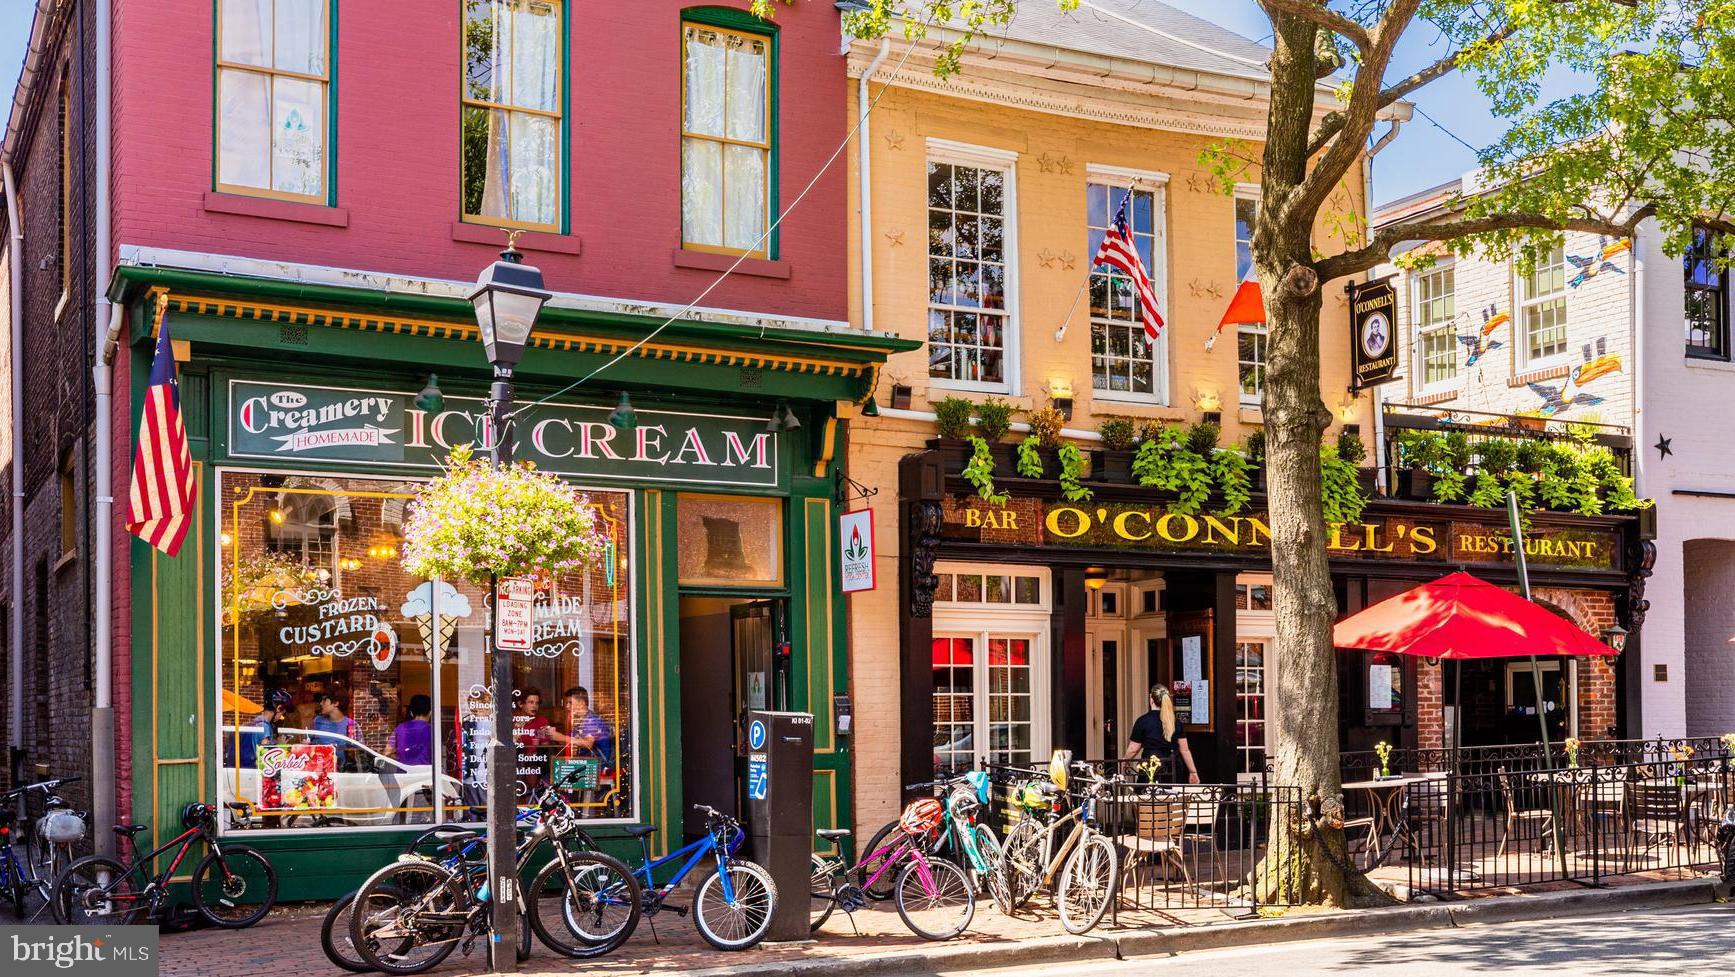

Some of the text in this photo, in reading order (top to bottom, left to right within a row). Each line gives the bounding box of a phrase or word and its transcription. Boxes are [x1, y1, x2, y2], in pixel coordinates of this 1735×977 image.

[1359, 357, 1394, 373] RESTAURANT
[275, 391, 304, 404] The
[240, 395, 394, 434] Creamery
[297, 431, 377, 448] HOMEMADE
[531, 418, 772, 470] CREAM
[964, 508, 1019, 530] BAR
[1045, 507, 1437, 554] O'CONNLL'S
[1459, 534, 1597, 559] RESTURANT
[319, 597, 378, 619] FROZEN
[503, 601, 528, 609] LOADING
[280, 614, 379, 645] CUSTARD
[532, 617, 584, 643] REAM
[469, 728, 491, 736] Indo
[263, 748, 310, 777] Sorbet
[518, 754, 548, 762] Sorbet
